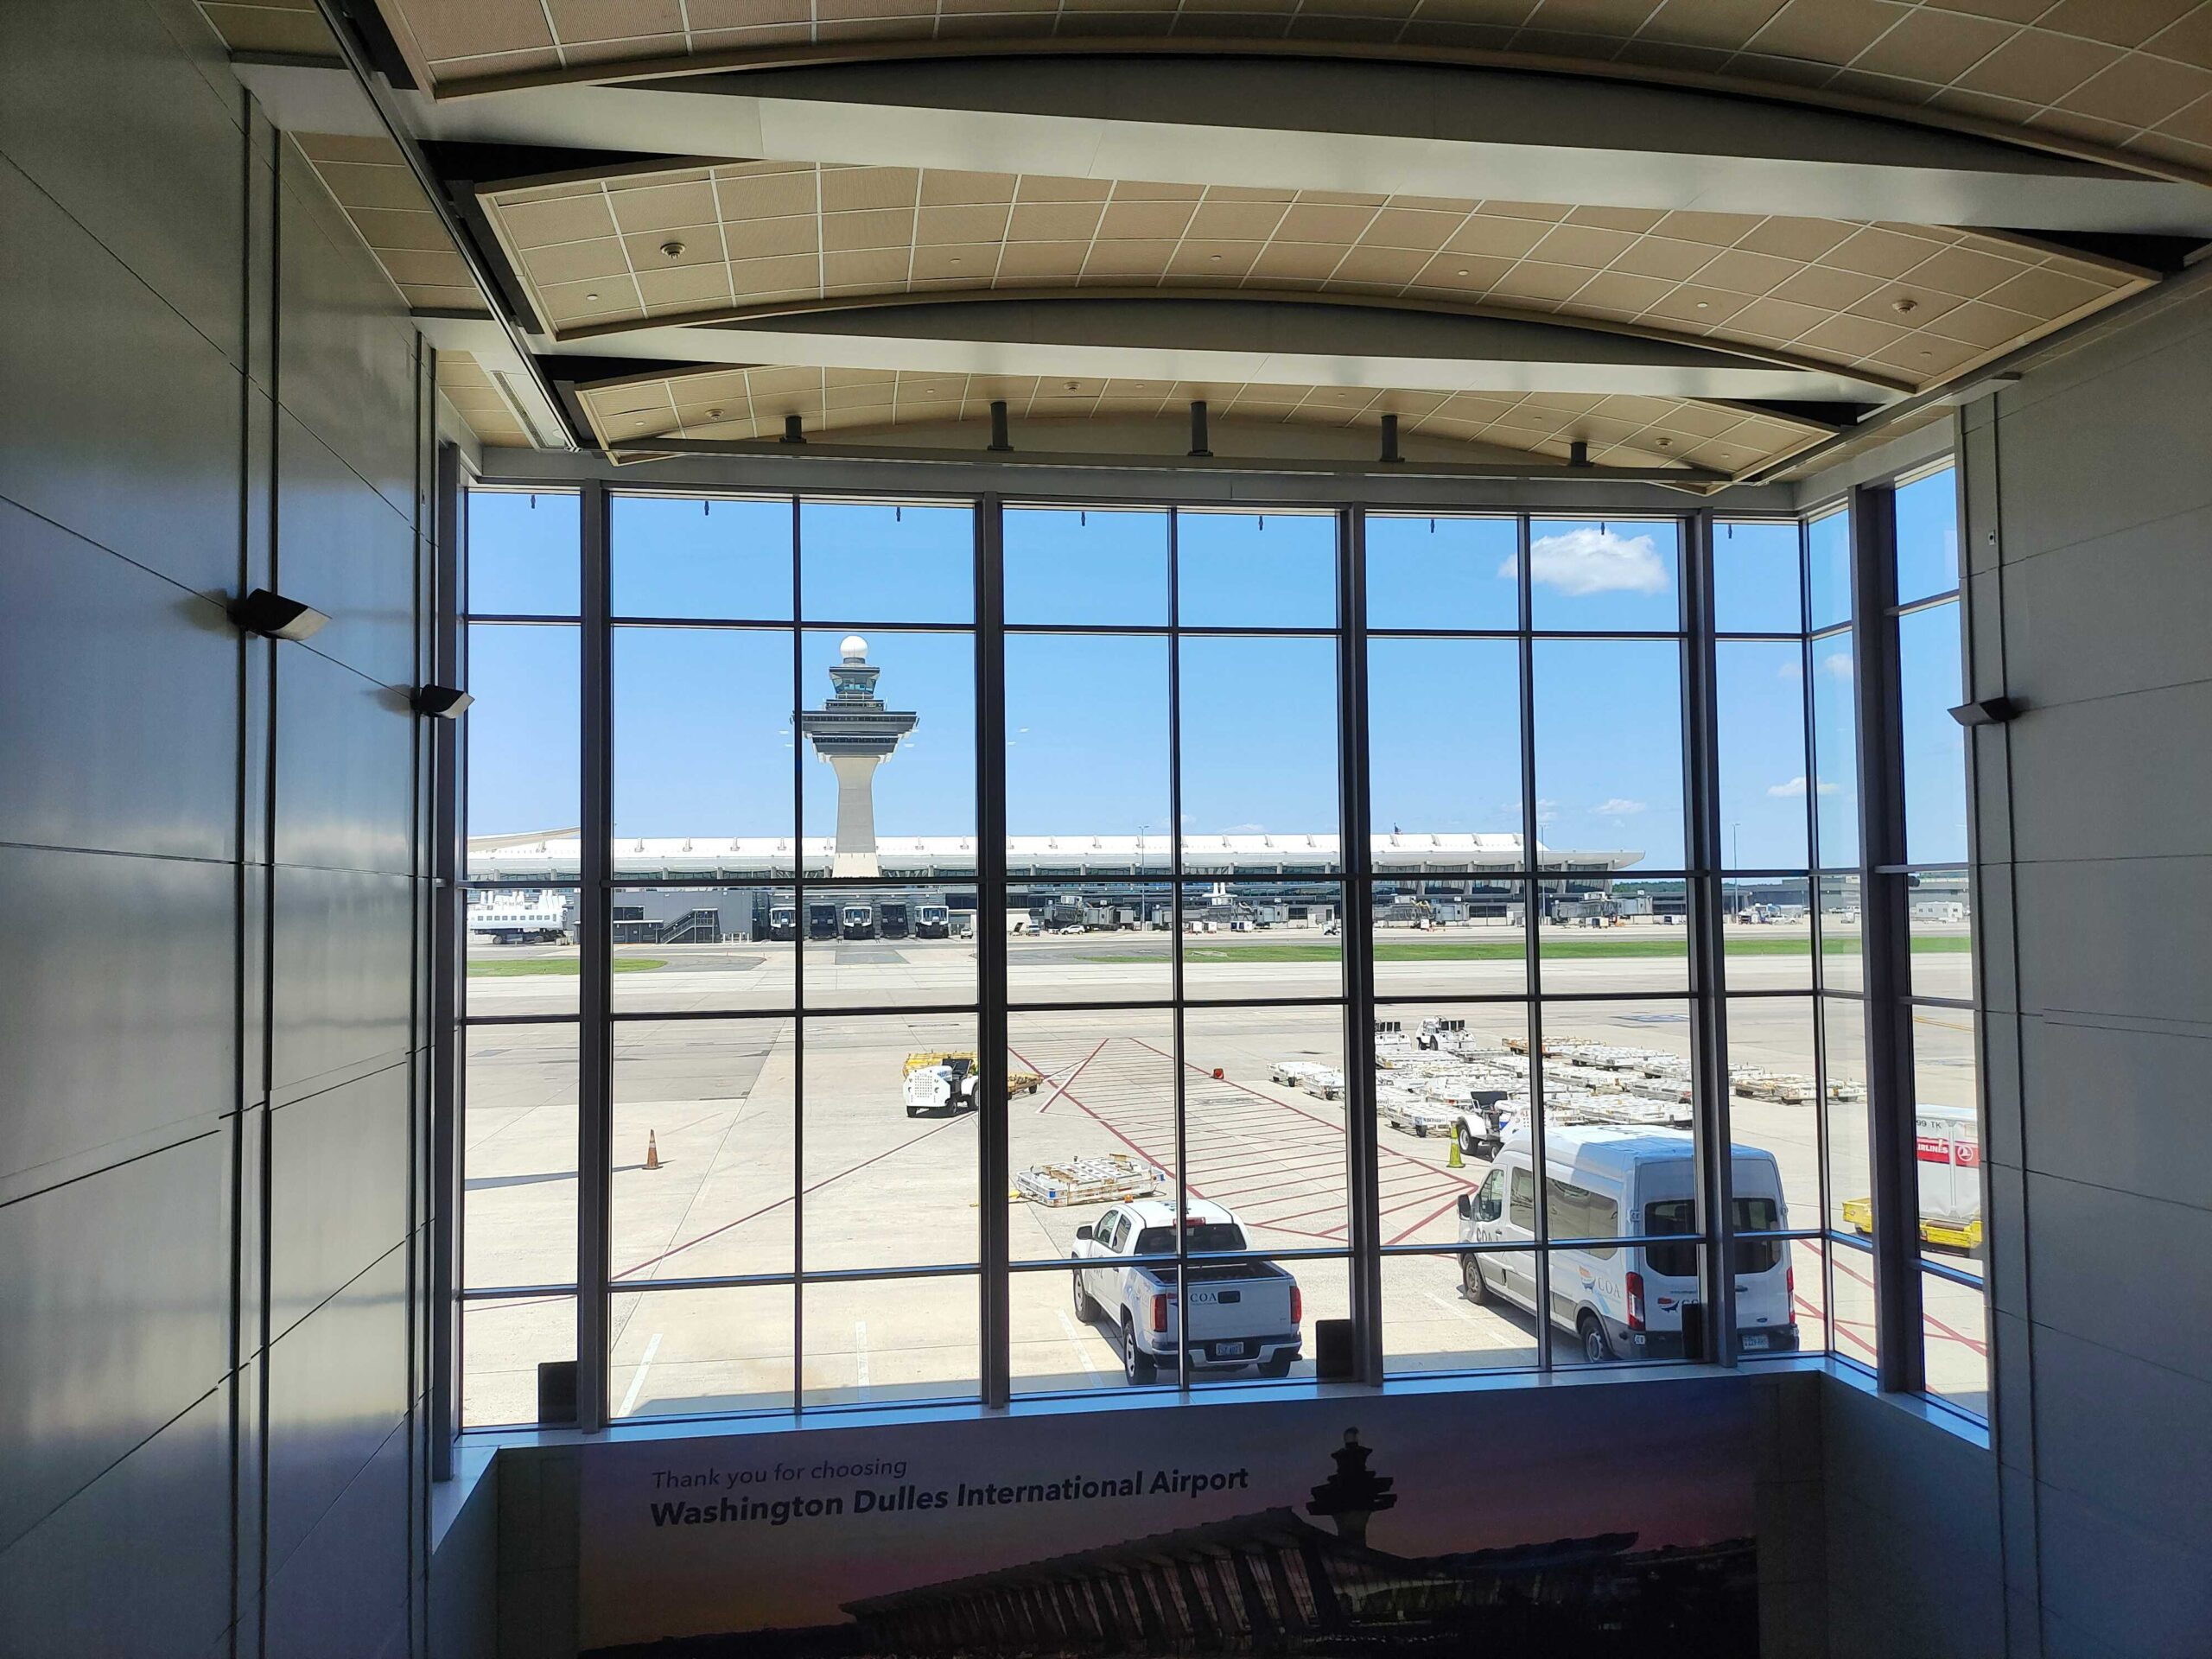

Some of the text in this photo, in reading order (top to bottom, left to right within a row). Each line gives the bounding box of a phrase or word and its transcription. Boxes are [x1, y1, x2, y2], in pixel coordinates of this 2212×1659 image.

[1190, 1293, 1217, 1302] COA
[1598, 1277, 1621, 1298] COA
[652, 1459, 907, 1490] Thank you for choosing
[650, 1468, 1249, 1527] Washington Dulles International Airport
